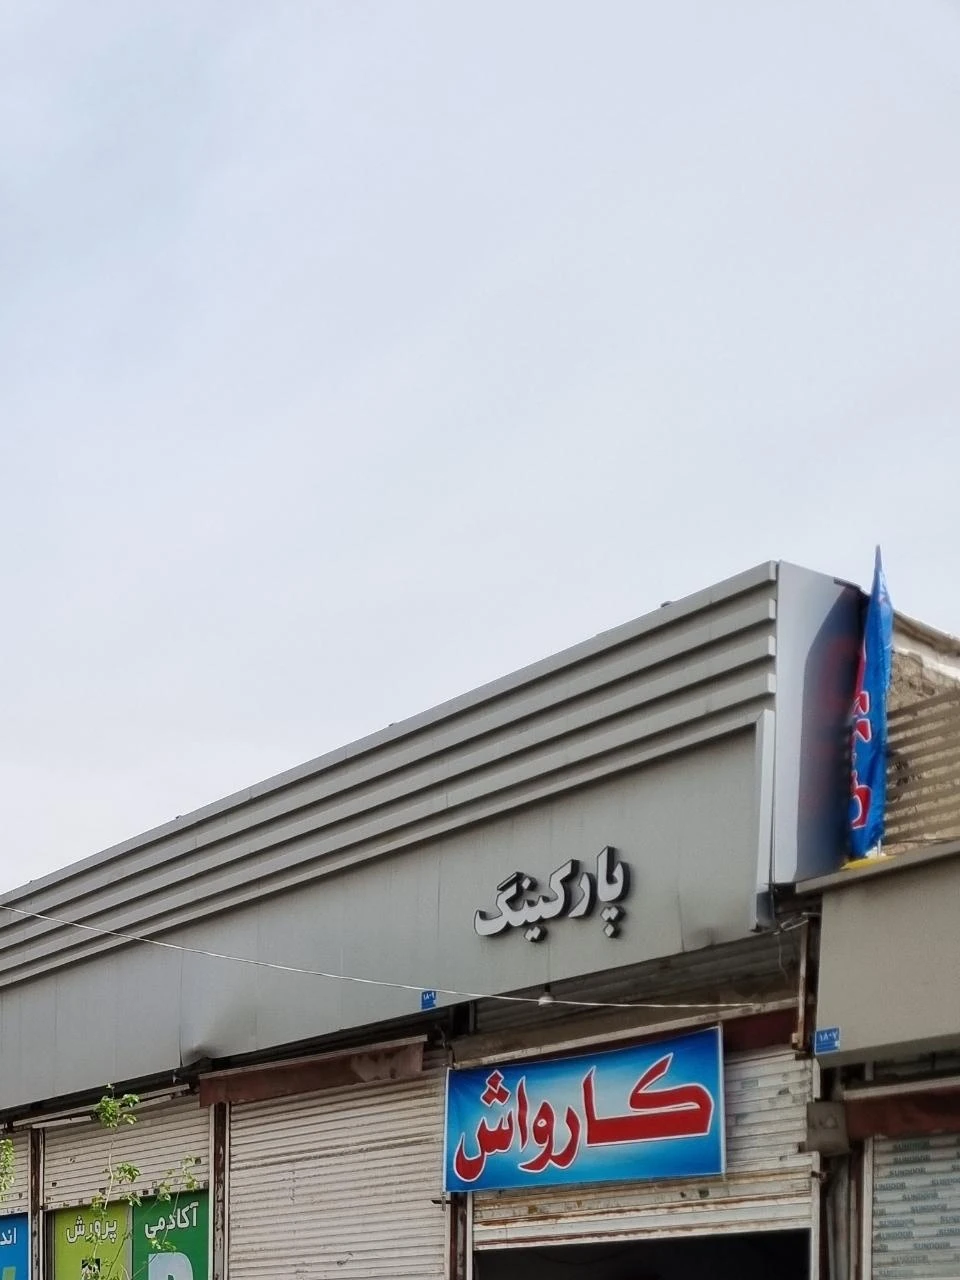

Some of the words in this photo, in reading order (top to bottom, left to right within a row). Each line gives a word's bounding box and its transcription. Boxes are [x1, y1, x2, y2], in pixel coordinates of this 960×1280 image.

[473, 845, 631, 942] پارکینگ
[453, 1052, 715, 1182] کارواش
[66, 1215, 118, 1243] پرورش
[144, 1201, 199, 1239] آکادمی
